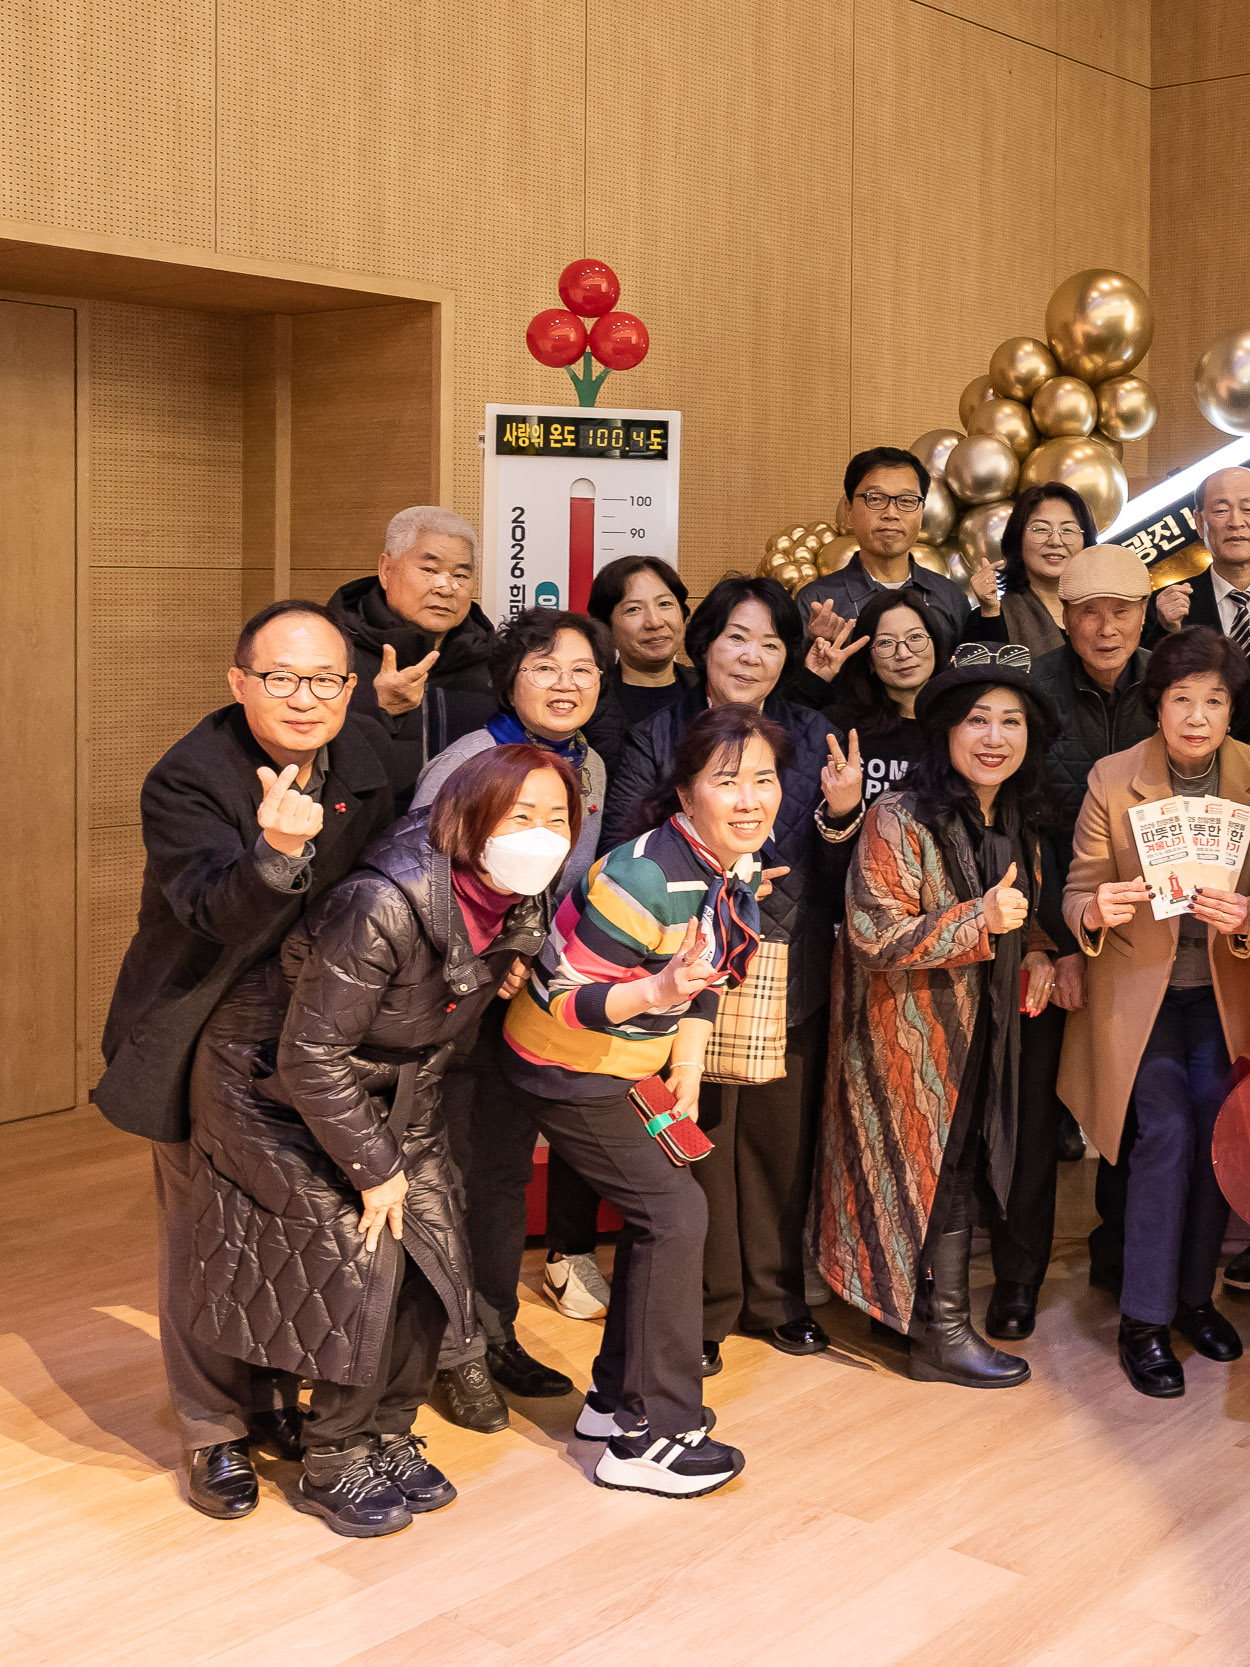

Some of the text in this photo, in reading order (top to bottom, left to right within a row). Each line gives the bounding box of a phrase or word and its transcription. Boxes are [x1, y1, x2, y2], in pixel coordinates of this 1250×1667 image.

[503, 422, 544, 447] 사랑의
[549, 423, 576, 448] 온도
[630, 496, 652, 507] 100
[510, 506, 526, 579] 2026
[630, 528, 645, 539] 90
[1120, 514, 1186, 564] 광진
[859, 757, 909, 780] OM
[1141, 823, 1183, 844] 따뜻한
[1189, 824, 1222, 837] 뜻한
[1144, 836, 1185, 853] 겨울나기
